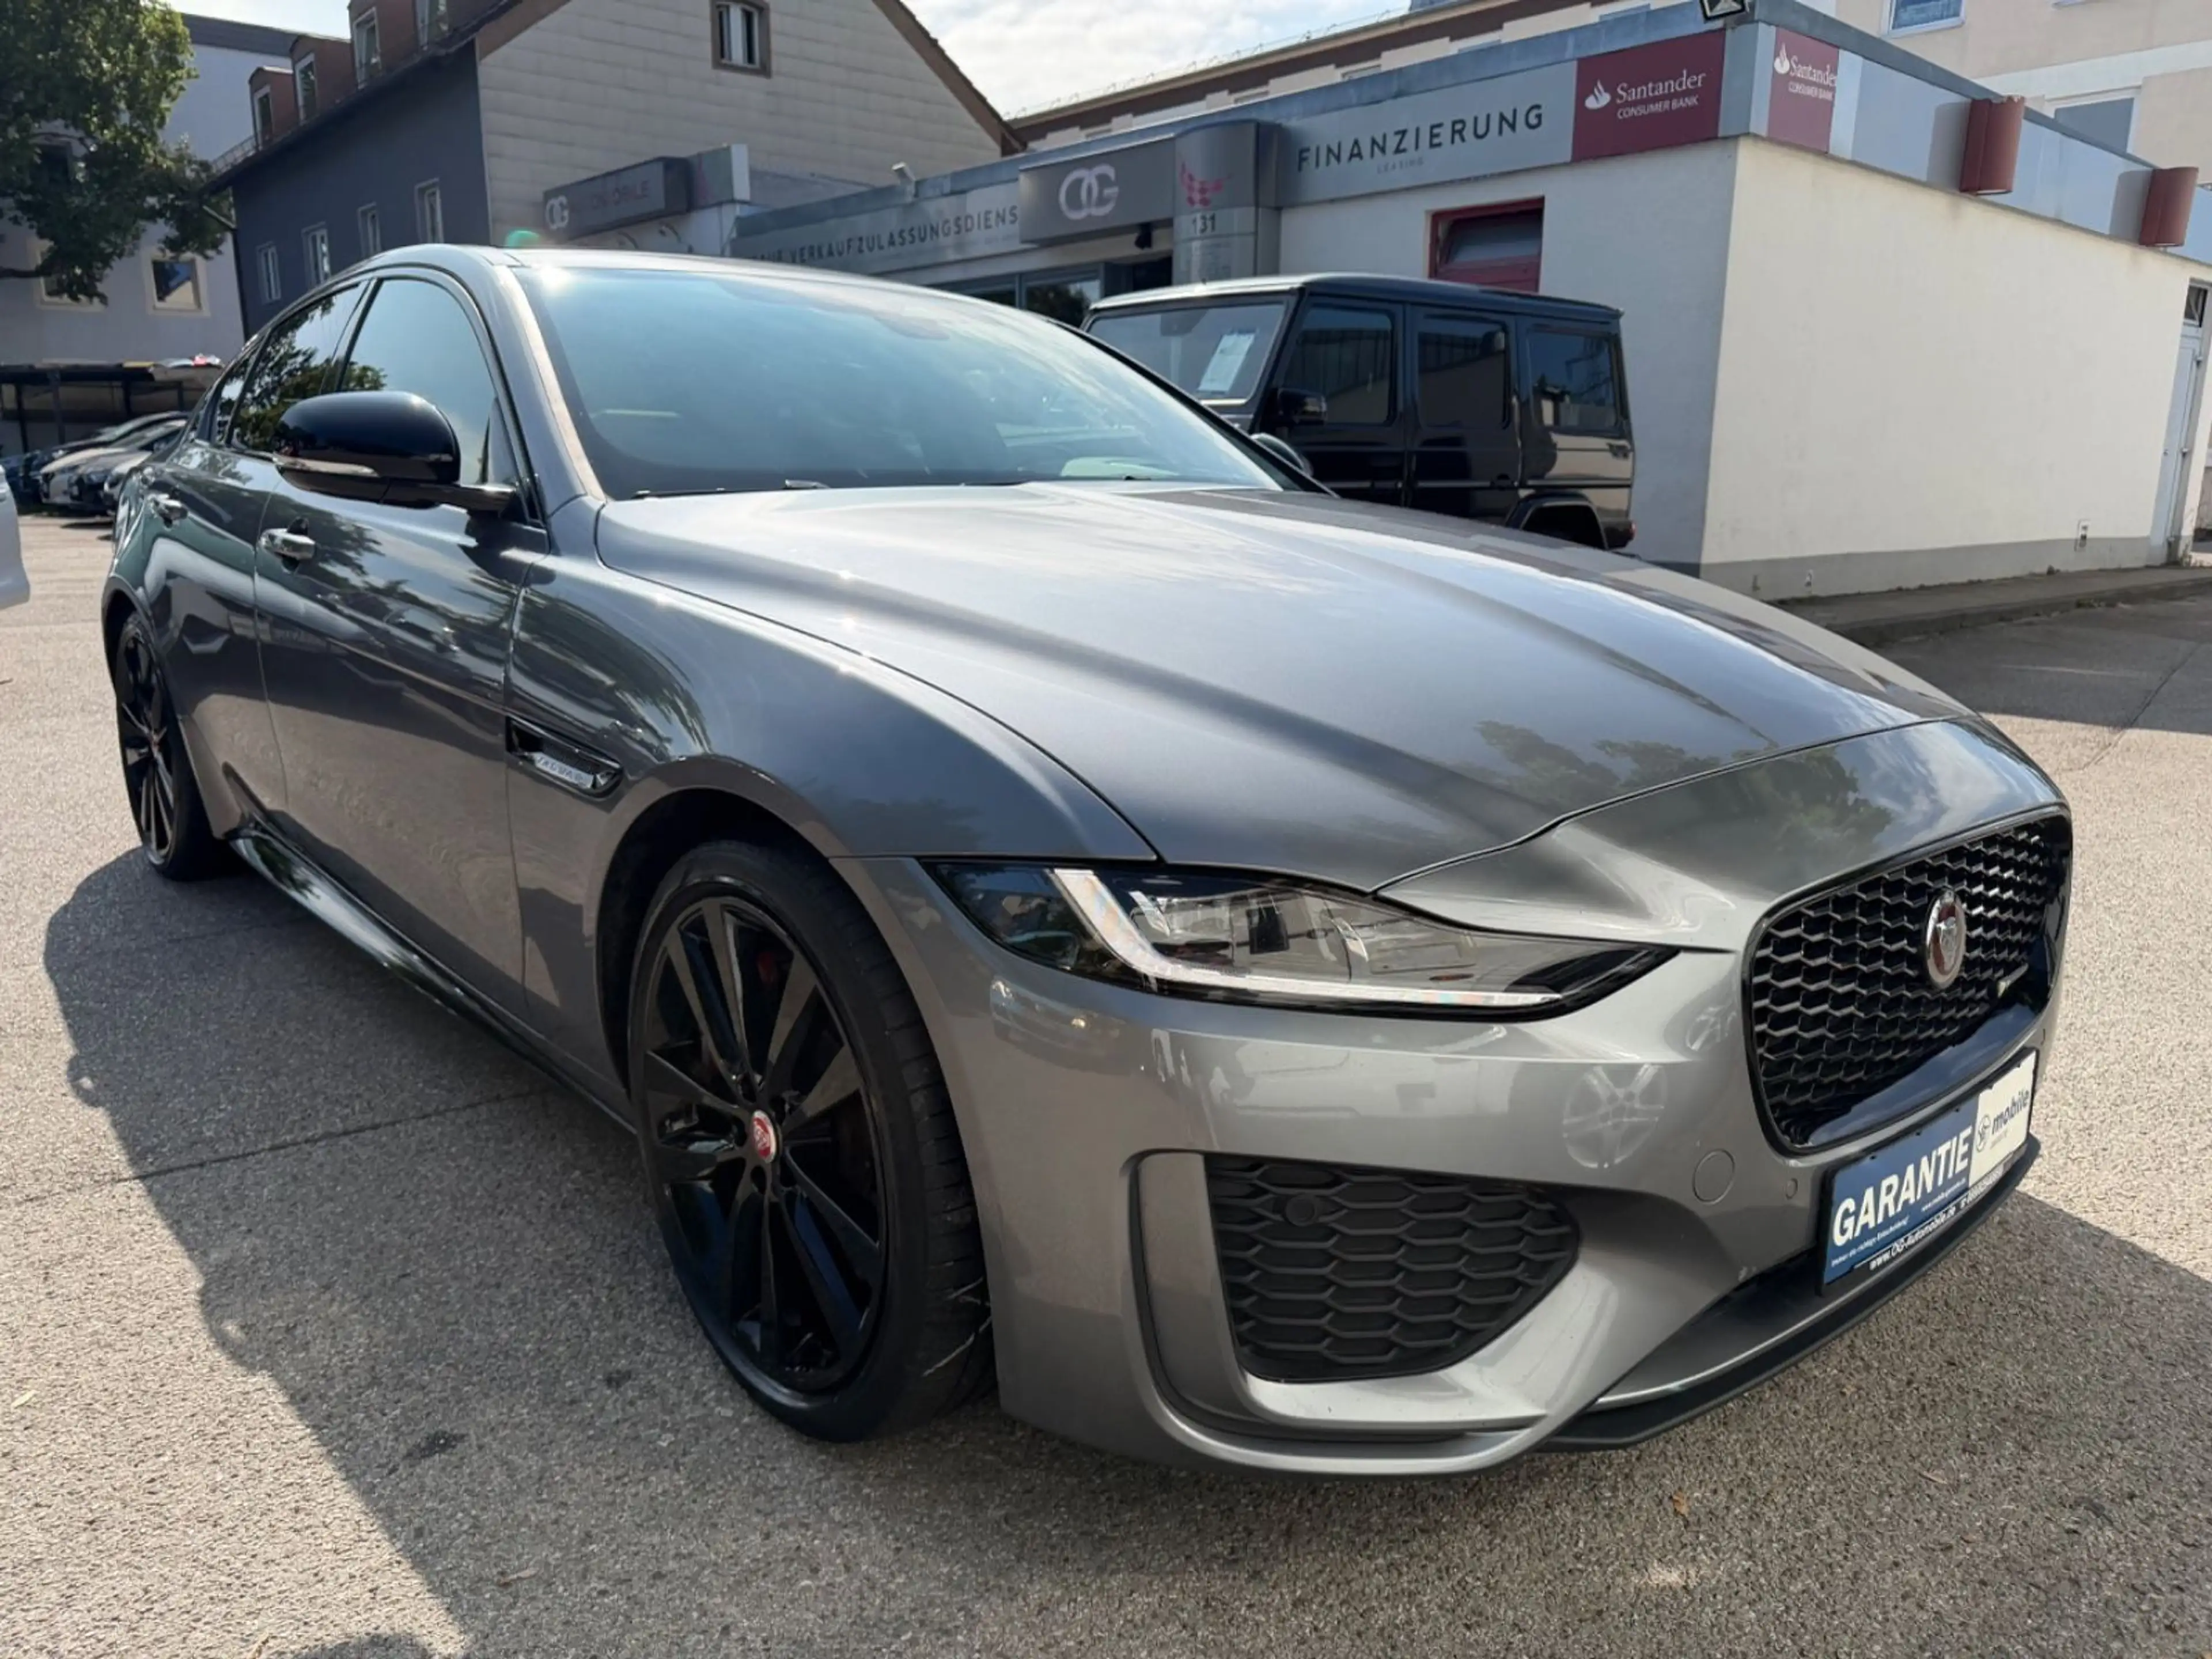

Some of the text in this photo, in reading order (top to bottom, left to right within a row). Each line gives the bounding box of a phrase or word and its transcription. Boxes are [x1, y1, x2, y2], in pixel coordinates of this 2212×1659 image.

[1615, 69, 1706, 104] Santander
[1617, 95, 1699, 119] CONSUMER BANK
[1298, 104, 1543, 172] FINANZIERUNG
[1191, 212, 1216, 235] 131
[789, 243, 853, 264] VERKAUF
[1992, 1089, 2030, 1135] mobile
[1833, 1125, 1972, 1247] GARANTIE
